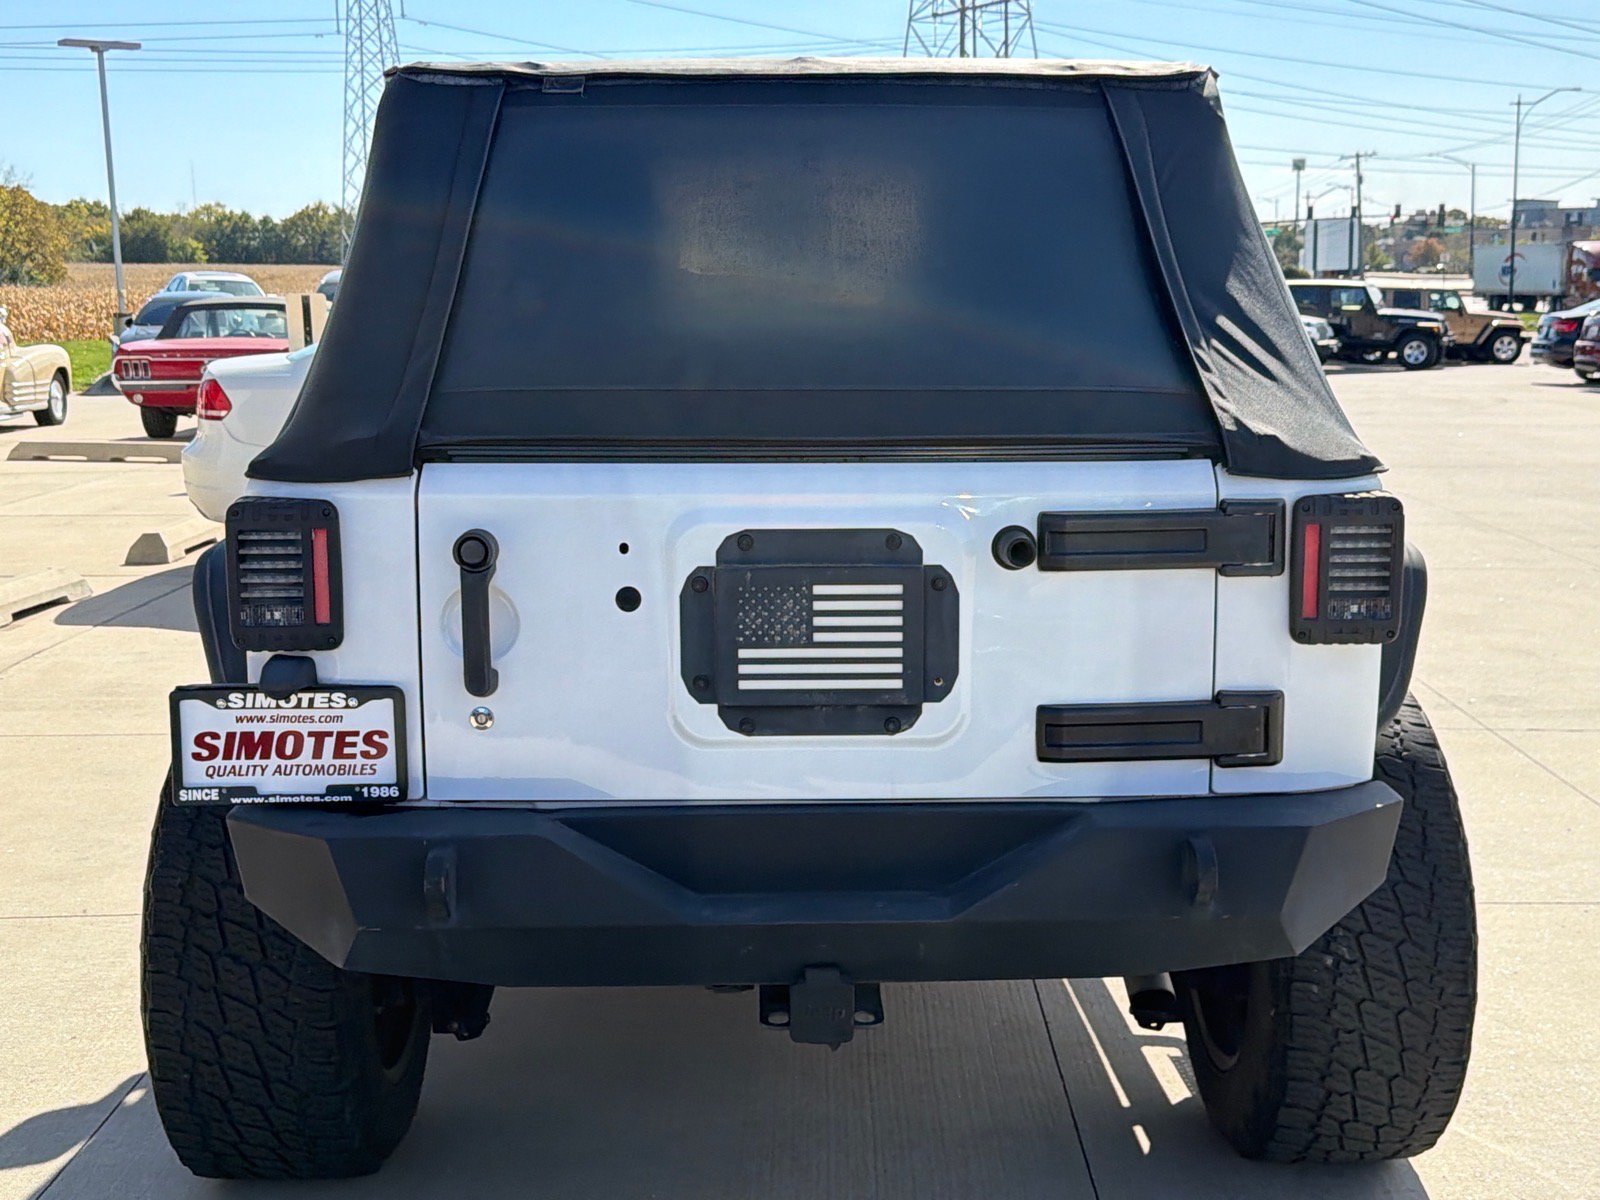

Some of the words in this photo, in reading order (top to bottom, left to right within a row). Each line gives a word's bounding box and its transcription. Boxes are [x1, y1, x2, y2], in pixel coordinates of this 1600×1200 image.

[227, 692, 347, 709] SIMOTES
[235, 713, 344, 724] www.simotes.com
[190, 730, 389, 762] SIMOTES
[205, 765, 269, 779] QUALITY
[272, 763, 378, 777] AUTOMOBILES
[179, 788, 220, 801] SINCE
[361, 786, 400, 798] 1986
[229, 794, 353, 804] www.simotes.com
